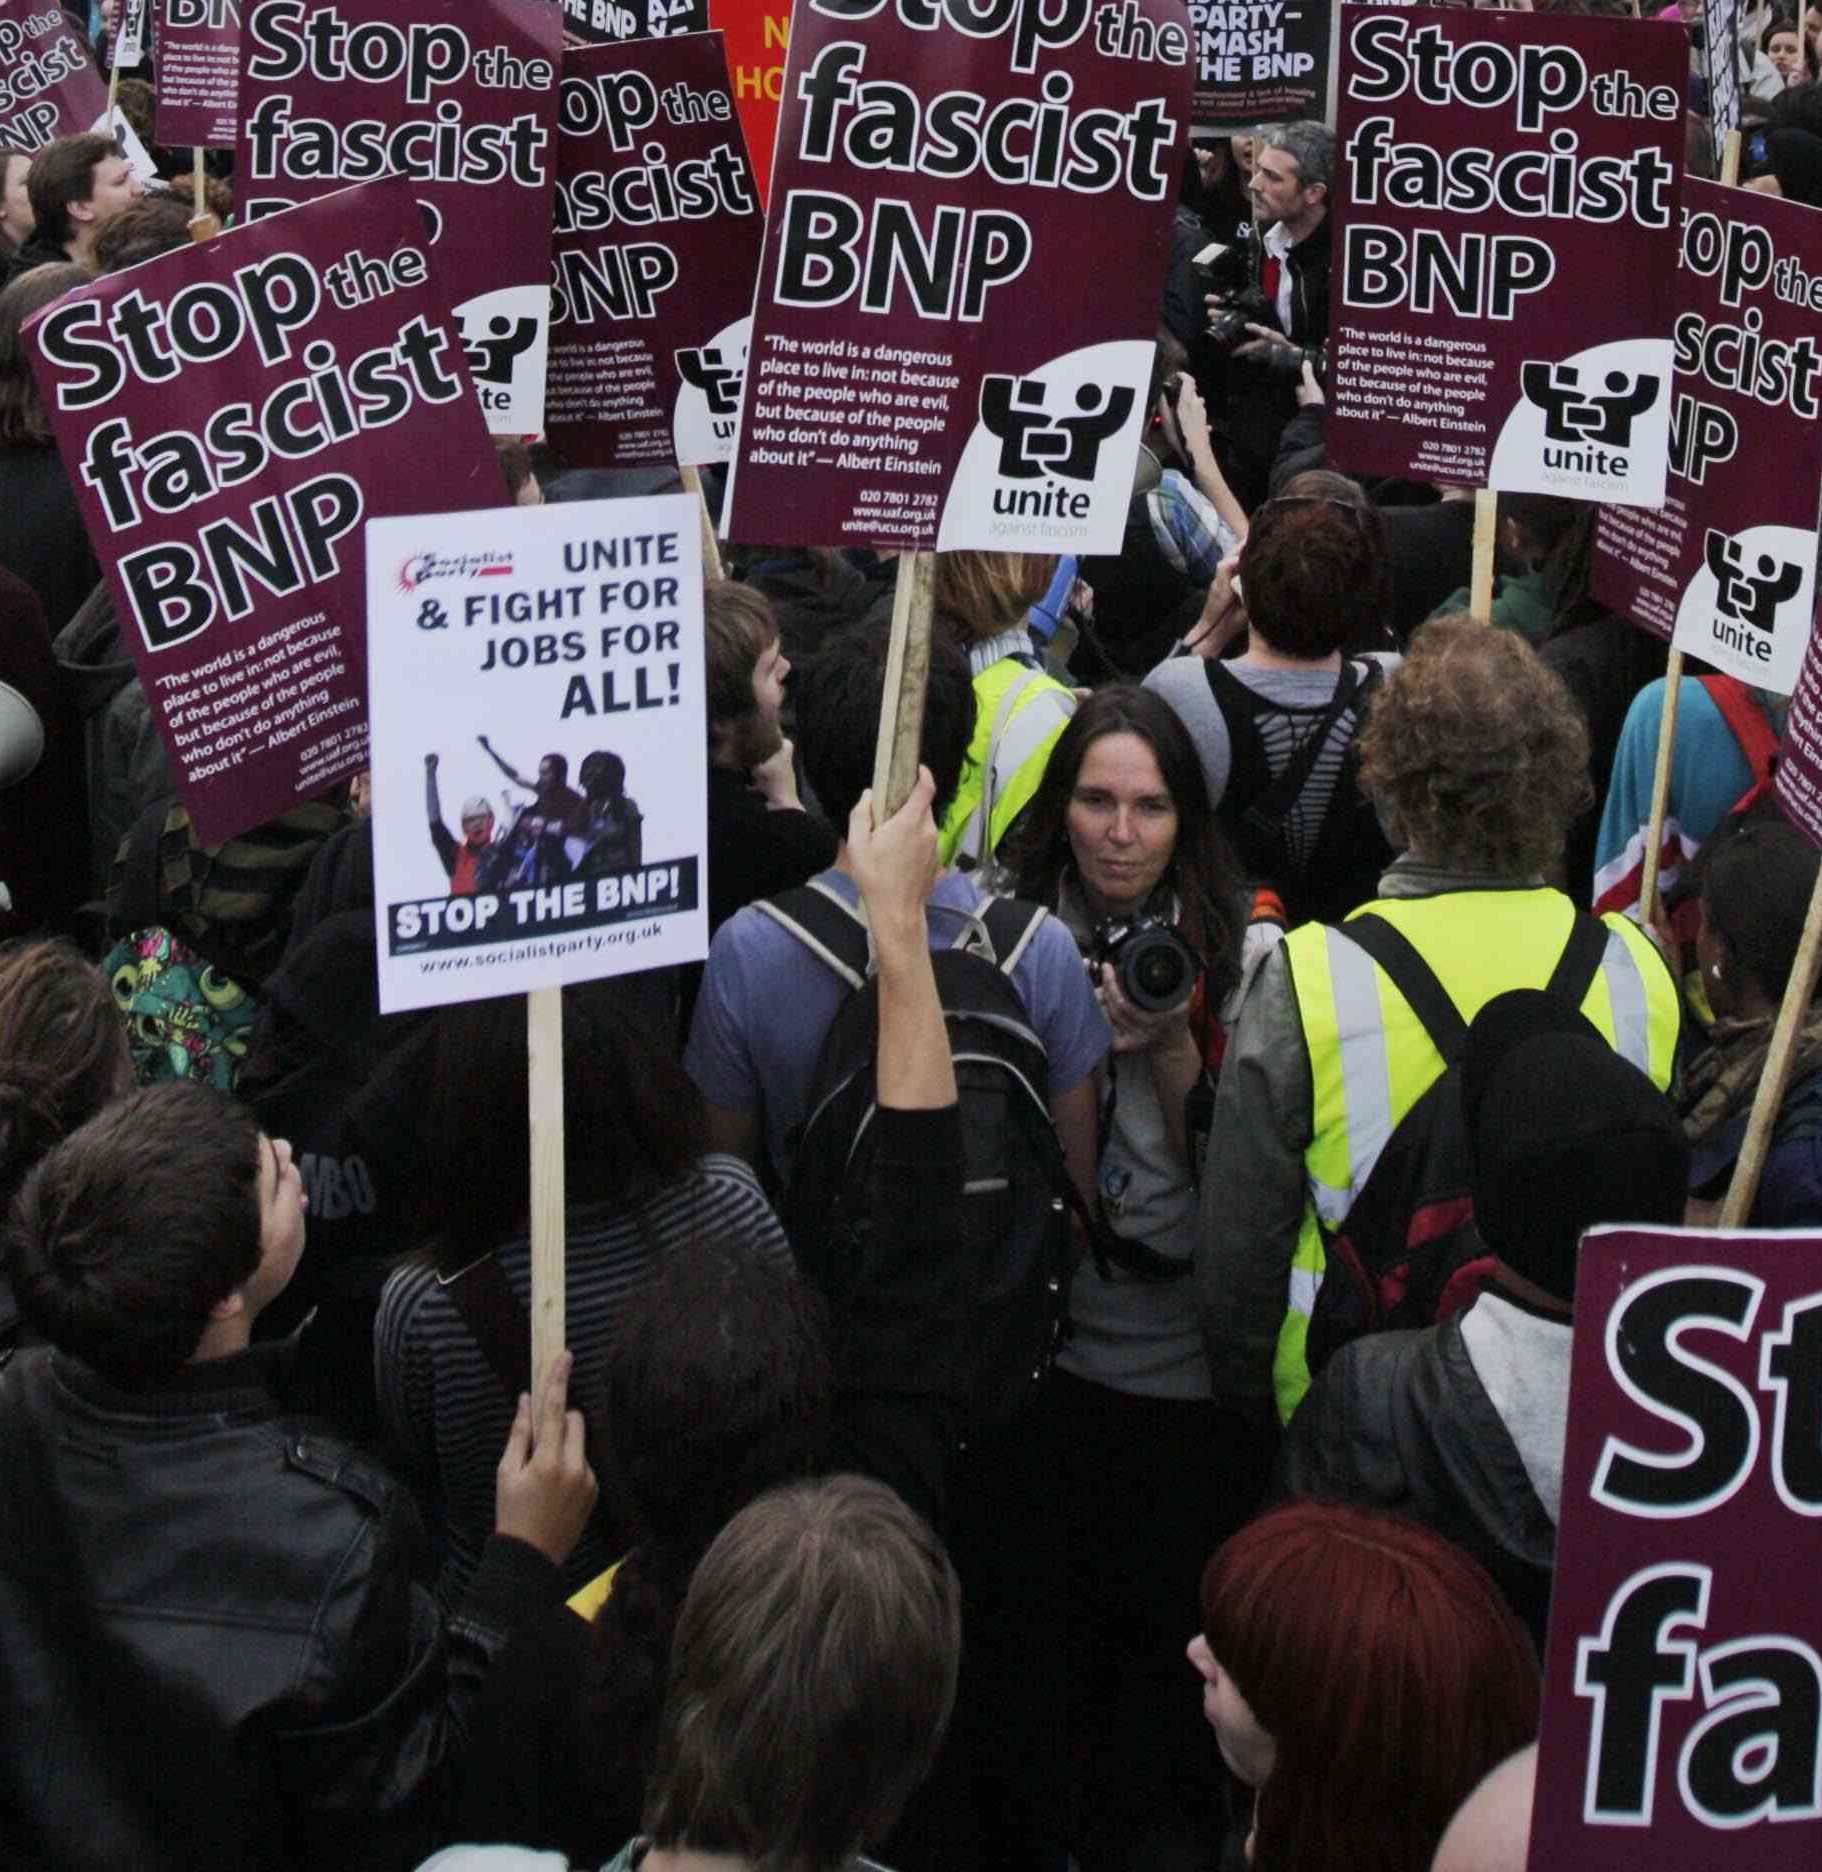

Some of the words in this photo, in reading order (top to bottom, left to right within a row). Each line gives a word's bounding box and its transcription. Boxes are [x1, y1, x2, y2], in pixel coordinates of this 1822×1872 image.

[247, 0, 472, 103] Stop
[473, 48, 553, 90] the
[1095, 0, 1188, 66] the
[1252, 52, 1314, 80] BNP
[1348, 17, 1587, 132] Stop
[1591, 70, 1678, 122] the
[247, 95, 546, 187] fascist
[799, 41, 1177, 200] fascist
[1346, 116, 1673, 228] fascist
[774, 190, 1031, 321] BNP
[1342, 226, 1555, 321] BNP
[36, 250, 323, 410] Stop
[325, 240, 428, 312] the
[760, 359, 800, 378] place
[804, 364, 818, 377] to
[824, 363, 848, 379] live
[852, 366, 870, 381] in:
[872, 368, 897, 383] not
[901, 371, 959, 388] because
[802, 341, 844, 357] world
[848, 344, 859, 356] is
[862, 348, 870, 359] a
[874, 345, 953, 367] dangerous
[756, 404, 781, 419] but
[785, 407, 844, 423] because
[848, 409, 866, 423] of
[869, 411, 891, 426] the
[895, 415, 945, 433] people
[758, 382, 774, 395] of
[777, 383, 801, 398] the
[805, 386, 855, 405] people
[860, 391, 890, 404] who
[895, 396, 918, 408] are
[922, 393, 949, 411] evil,
[80, 312, 465, 532] fascist
[753, 427, 785, 441] who
[831, 431, 849, 446] do
[853, 434, 918, 455] anything
[750, 450, 794, 465] about
[837, 456, 880, 470] Albert
[885, 457, 941, 475] Einstein
[1544, 445, 1627, 477] unite
[853, 506, 935, 521] www.uaf.org.uk
[860, 491, 880, 502] 020
[883, 493, 909, 504] 7801
[912, 494, 938, 506] 2782
[993, 481, 1090, 518] unite
[565, 533, 679, 573] UNITE
[842, 520, 934, 536] unite@ucu.org.uk
[117, 472, 365, 652] BNP
[417, 598, 449, 629] &
[465, 586, 585, 626] FIGHT
[600, 578, 679, 614] FOR
[481, 631, 586, 671] JOBS
[602, 622, 680, 658] FOR
[560, 664, 681, 720] ALL!
[395, 897, 498, 938] STOP
[510, 883, 585, 923] THE
[597, 867, 679, 911] BNP!
[421, 923, 662, 973] www.socialistparty.org.uk
